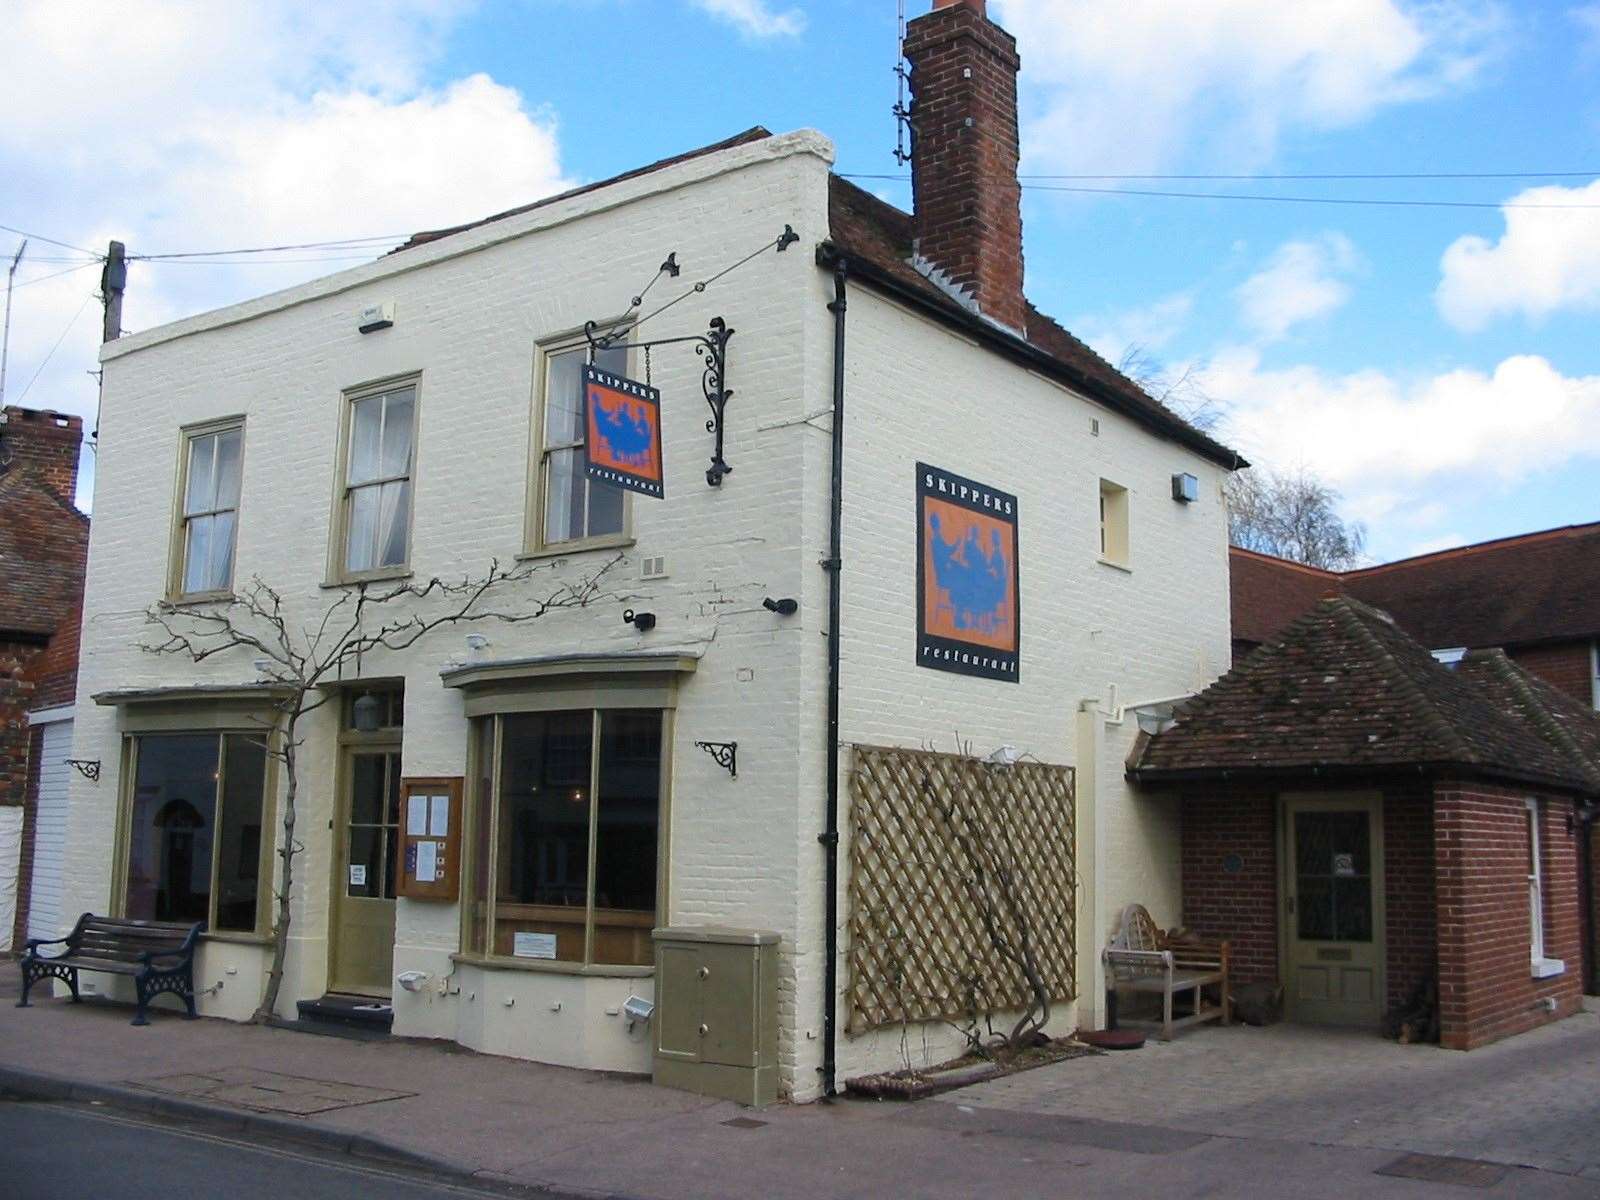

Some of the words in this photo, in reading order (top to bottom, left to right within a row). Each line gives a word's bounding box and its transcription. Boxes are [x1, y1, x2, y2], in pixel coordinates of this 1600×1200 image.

[588, 370, 655, 400] SKIPPERS
[589, 468, 660, 493] restaurant
[925, 474, 1012, 514] SKIPPERS
[923, 646, 1015, 672] restaurant
